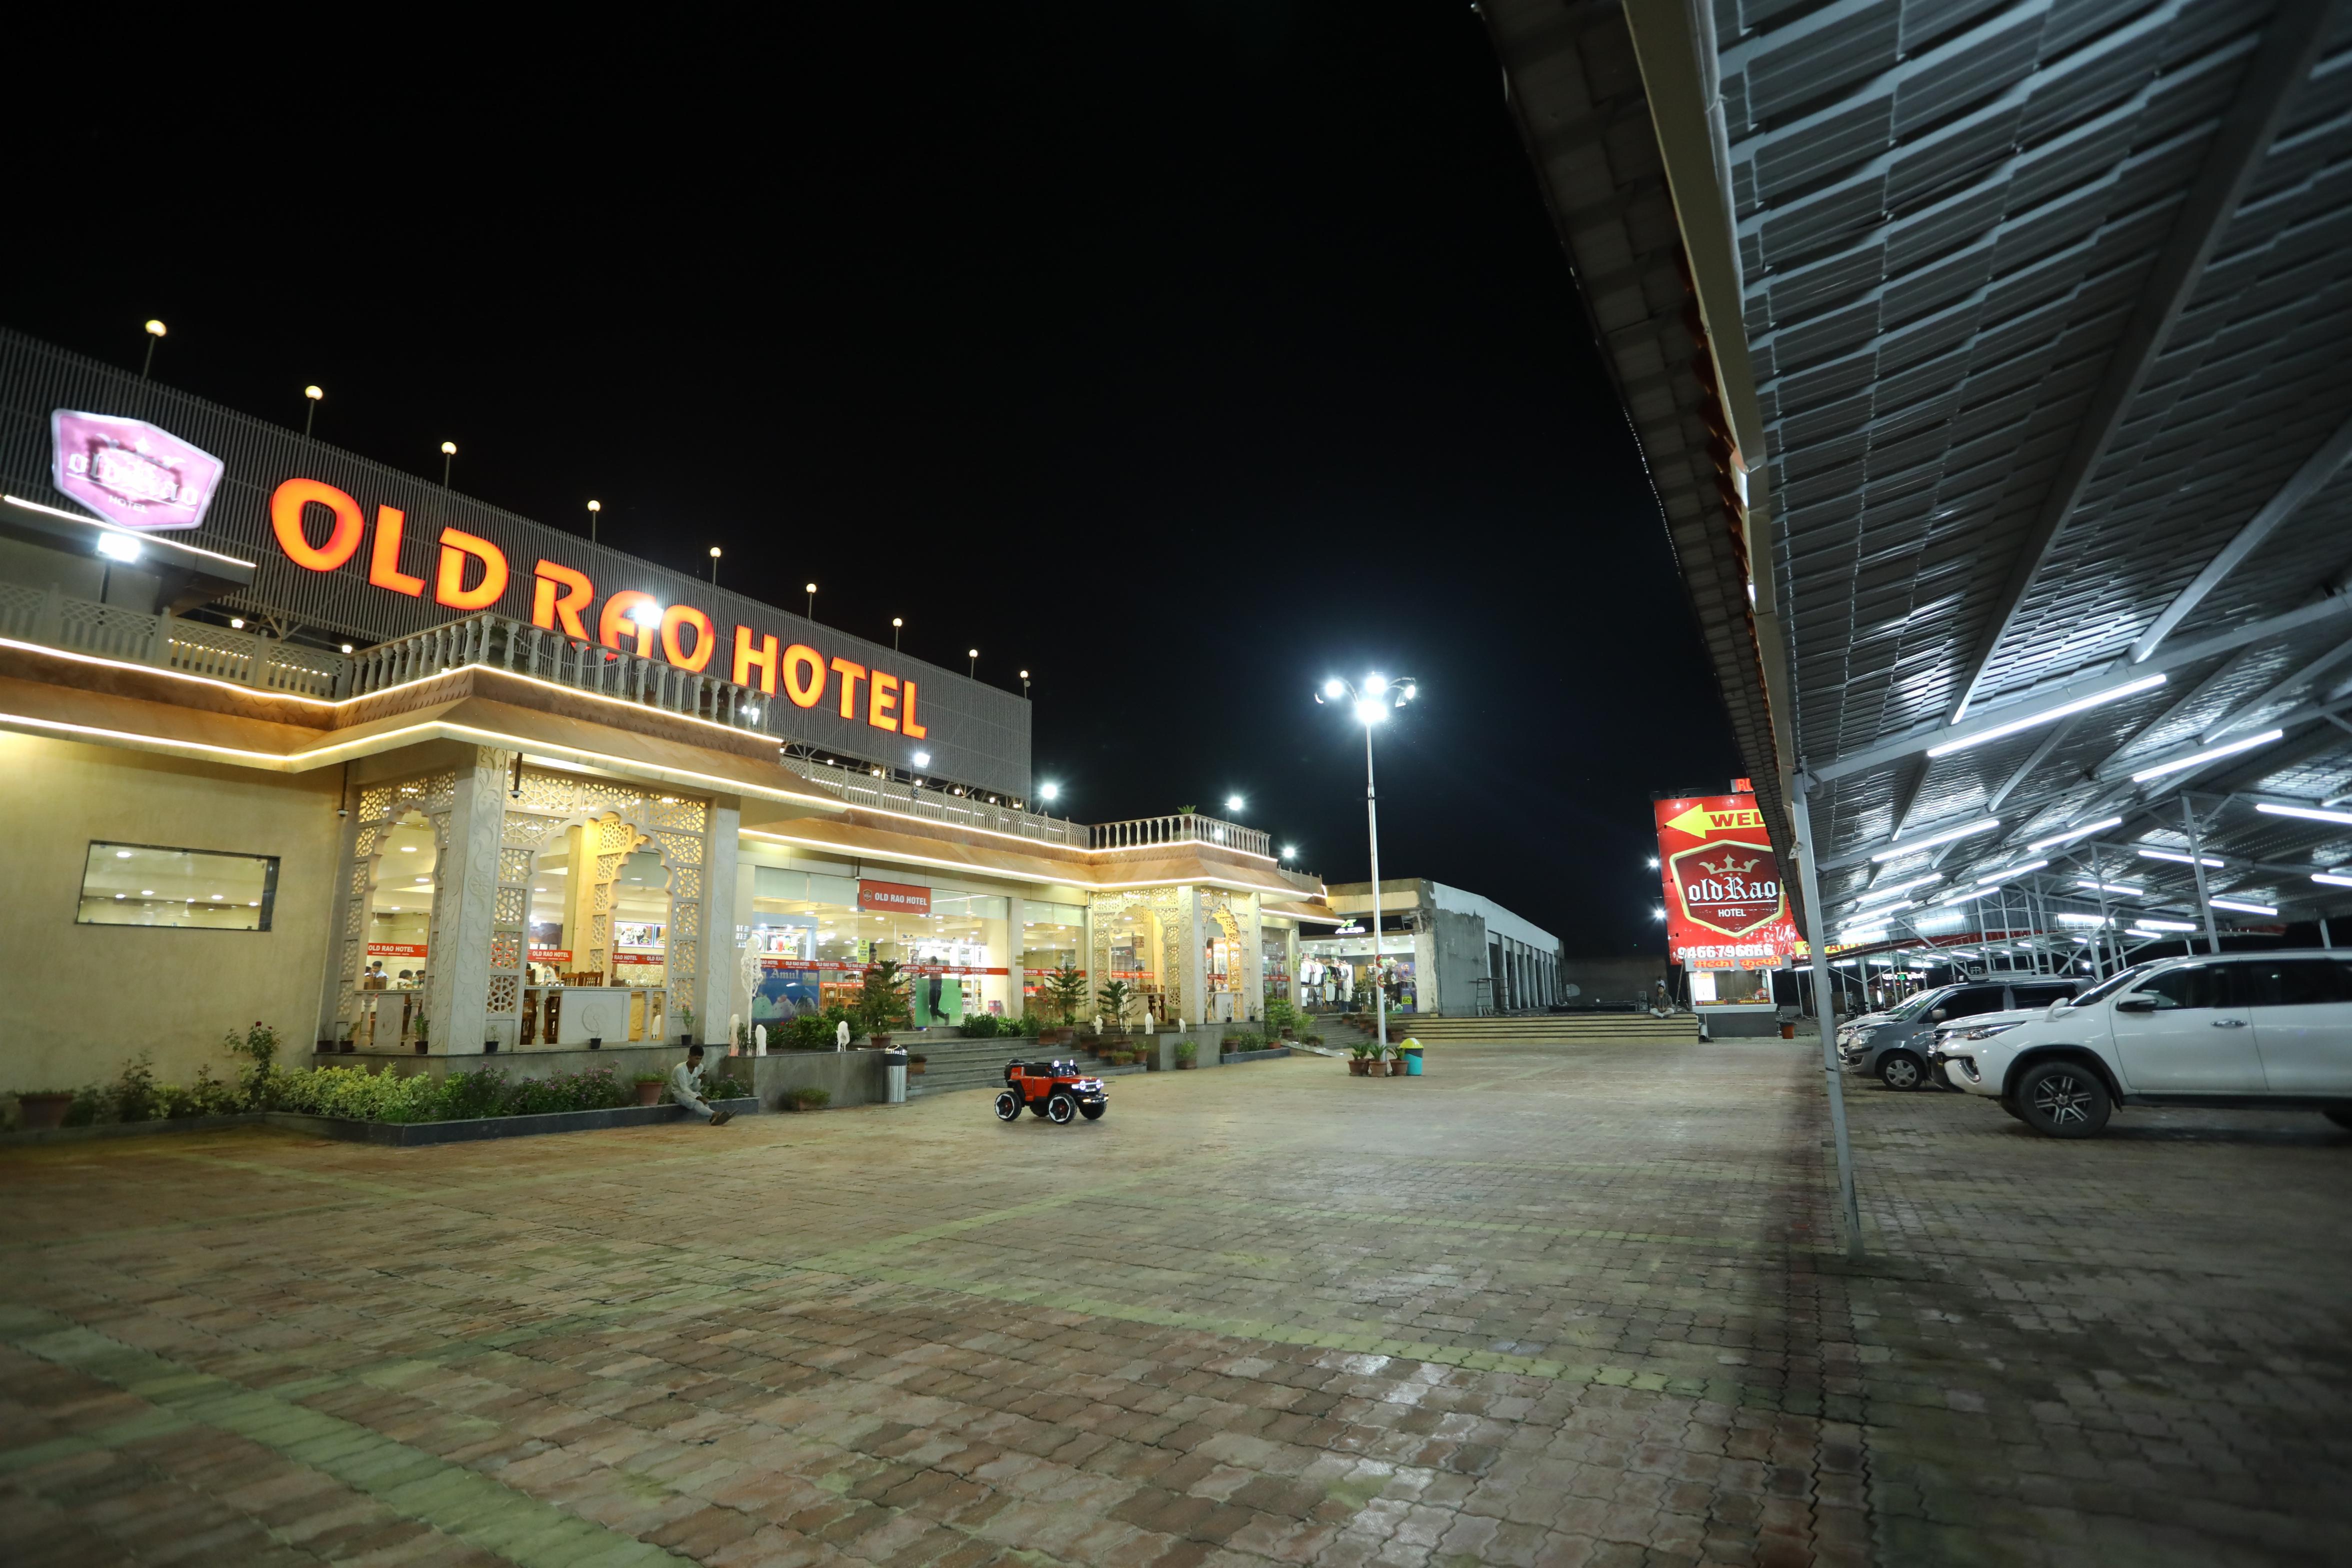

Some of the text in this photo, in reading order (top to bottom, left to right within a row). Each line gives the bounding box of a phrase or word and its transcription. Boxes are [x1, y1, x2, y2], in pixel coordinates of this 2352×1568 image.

[108, 495, 148, 513] HOTEL
[270, 478, 927, 740] OLD RAO HOTEL
[1710, 812, 1764, 828] WEL
[874, 892, 888, 902] OLD
[890, 894, 904, 904] RAO
[906, 896, 928, 906] HOTEL
[1718, 908, 1746, 917] HOTEL
[1694, 959, 1735, 968] मटका
[770, 968, 799, 979] Amul
